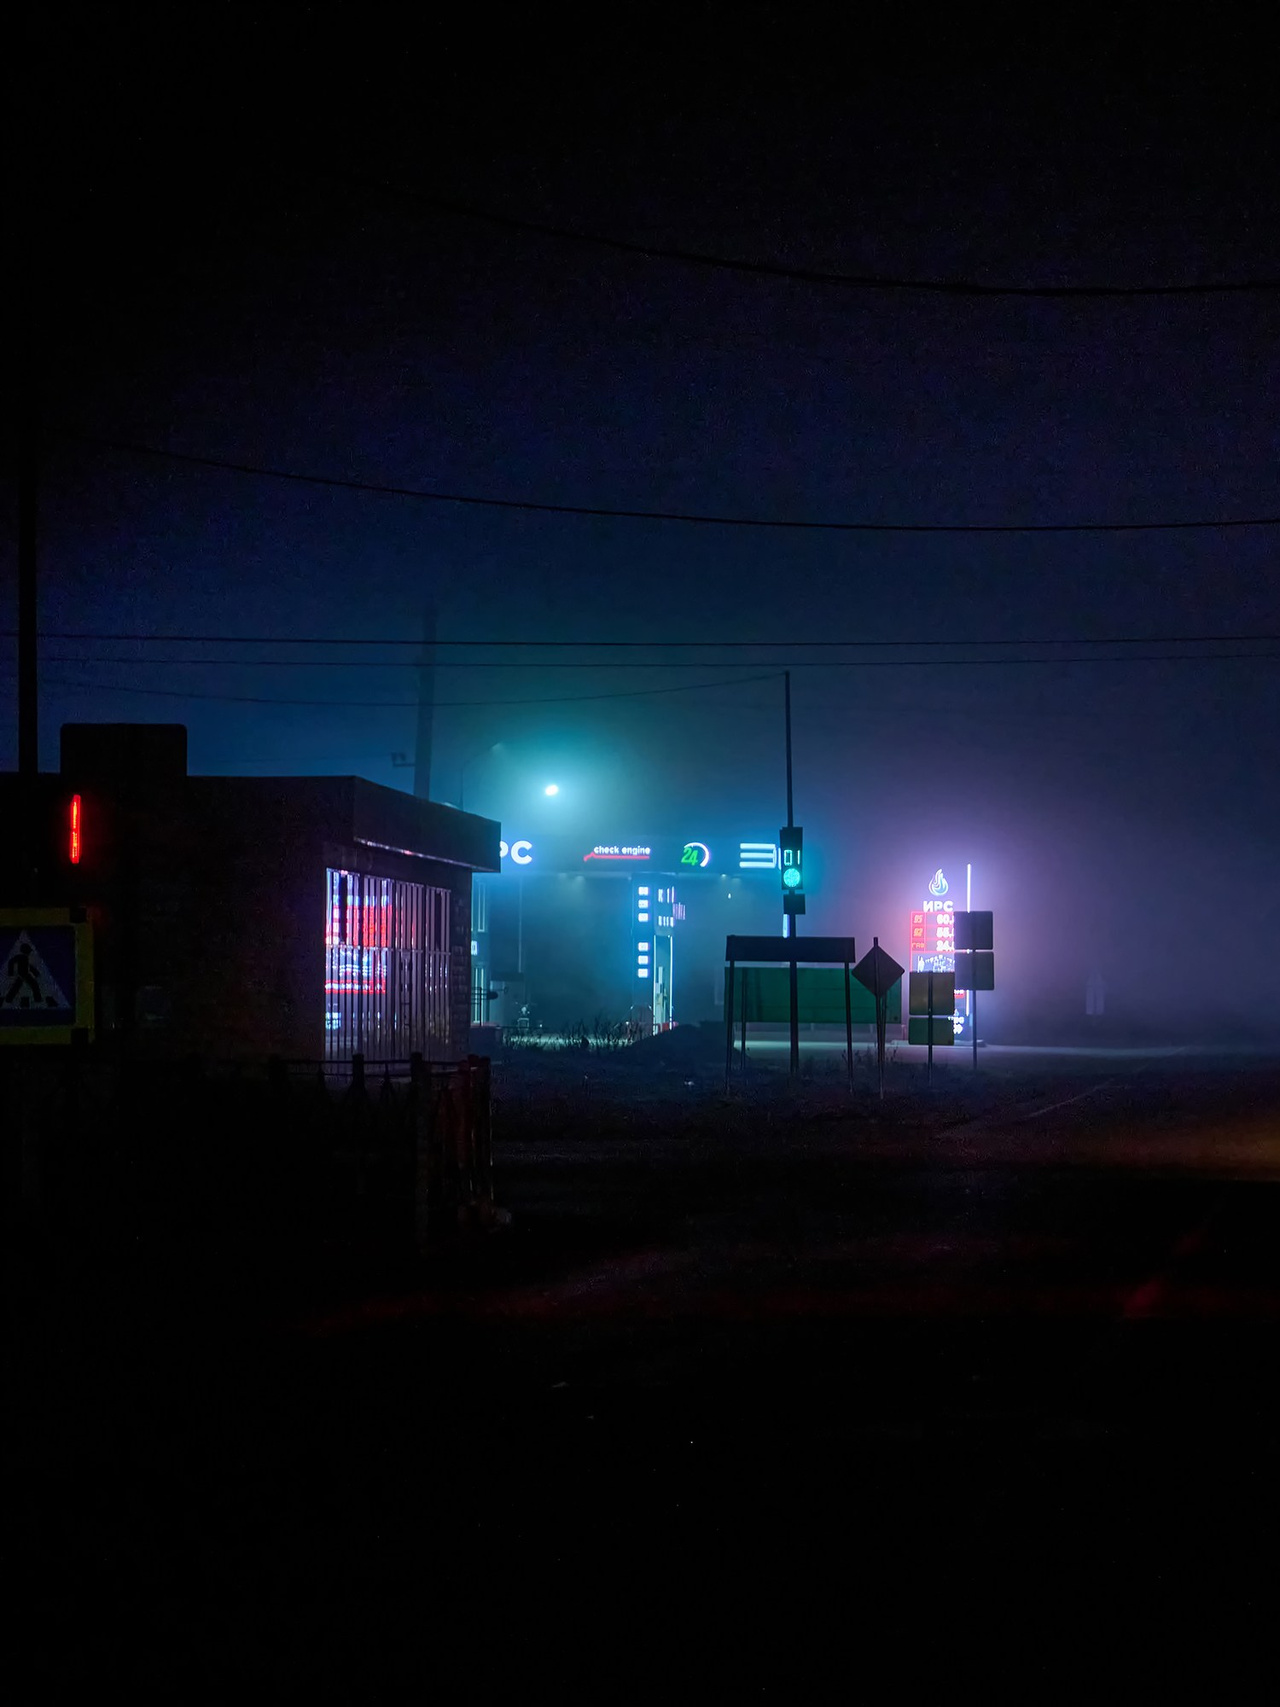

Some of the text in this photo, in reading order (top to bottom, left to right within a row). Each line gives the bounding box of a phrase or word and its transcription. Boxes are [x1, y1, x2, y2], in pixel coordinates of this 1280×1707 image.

[594, 846, 651, 856] check engine
[681, 847, 699, 866] 24
[923, 900, 954, 913] ИРС
